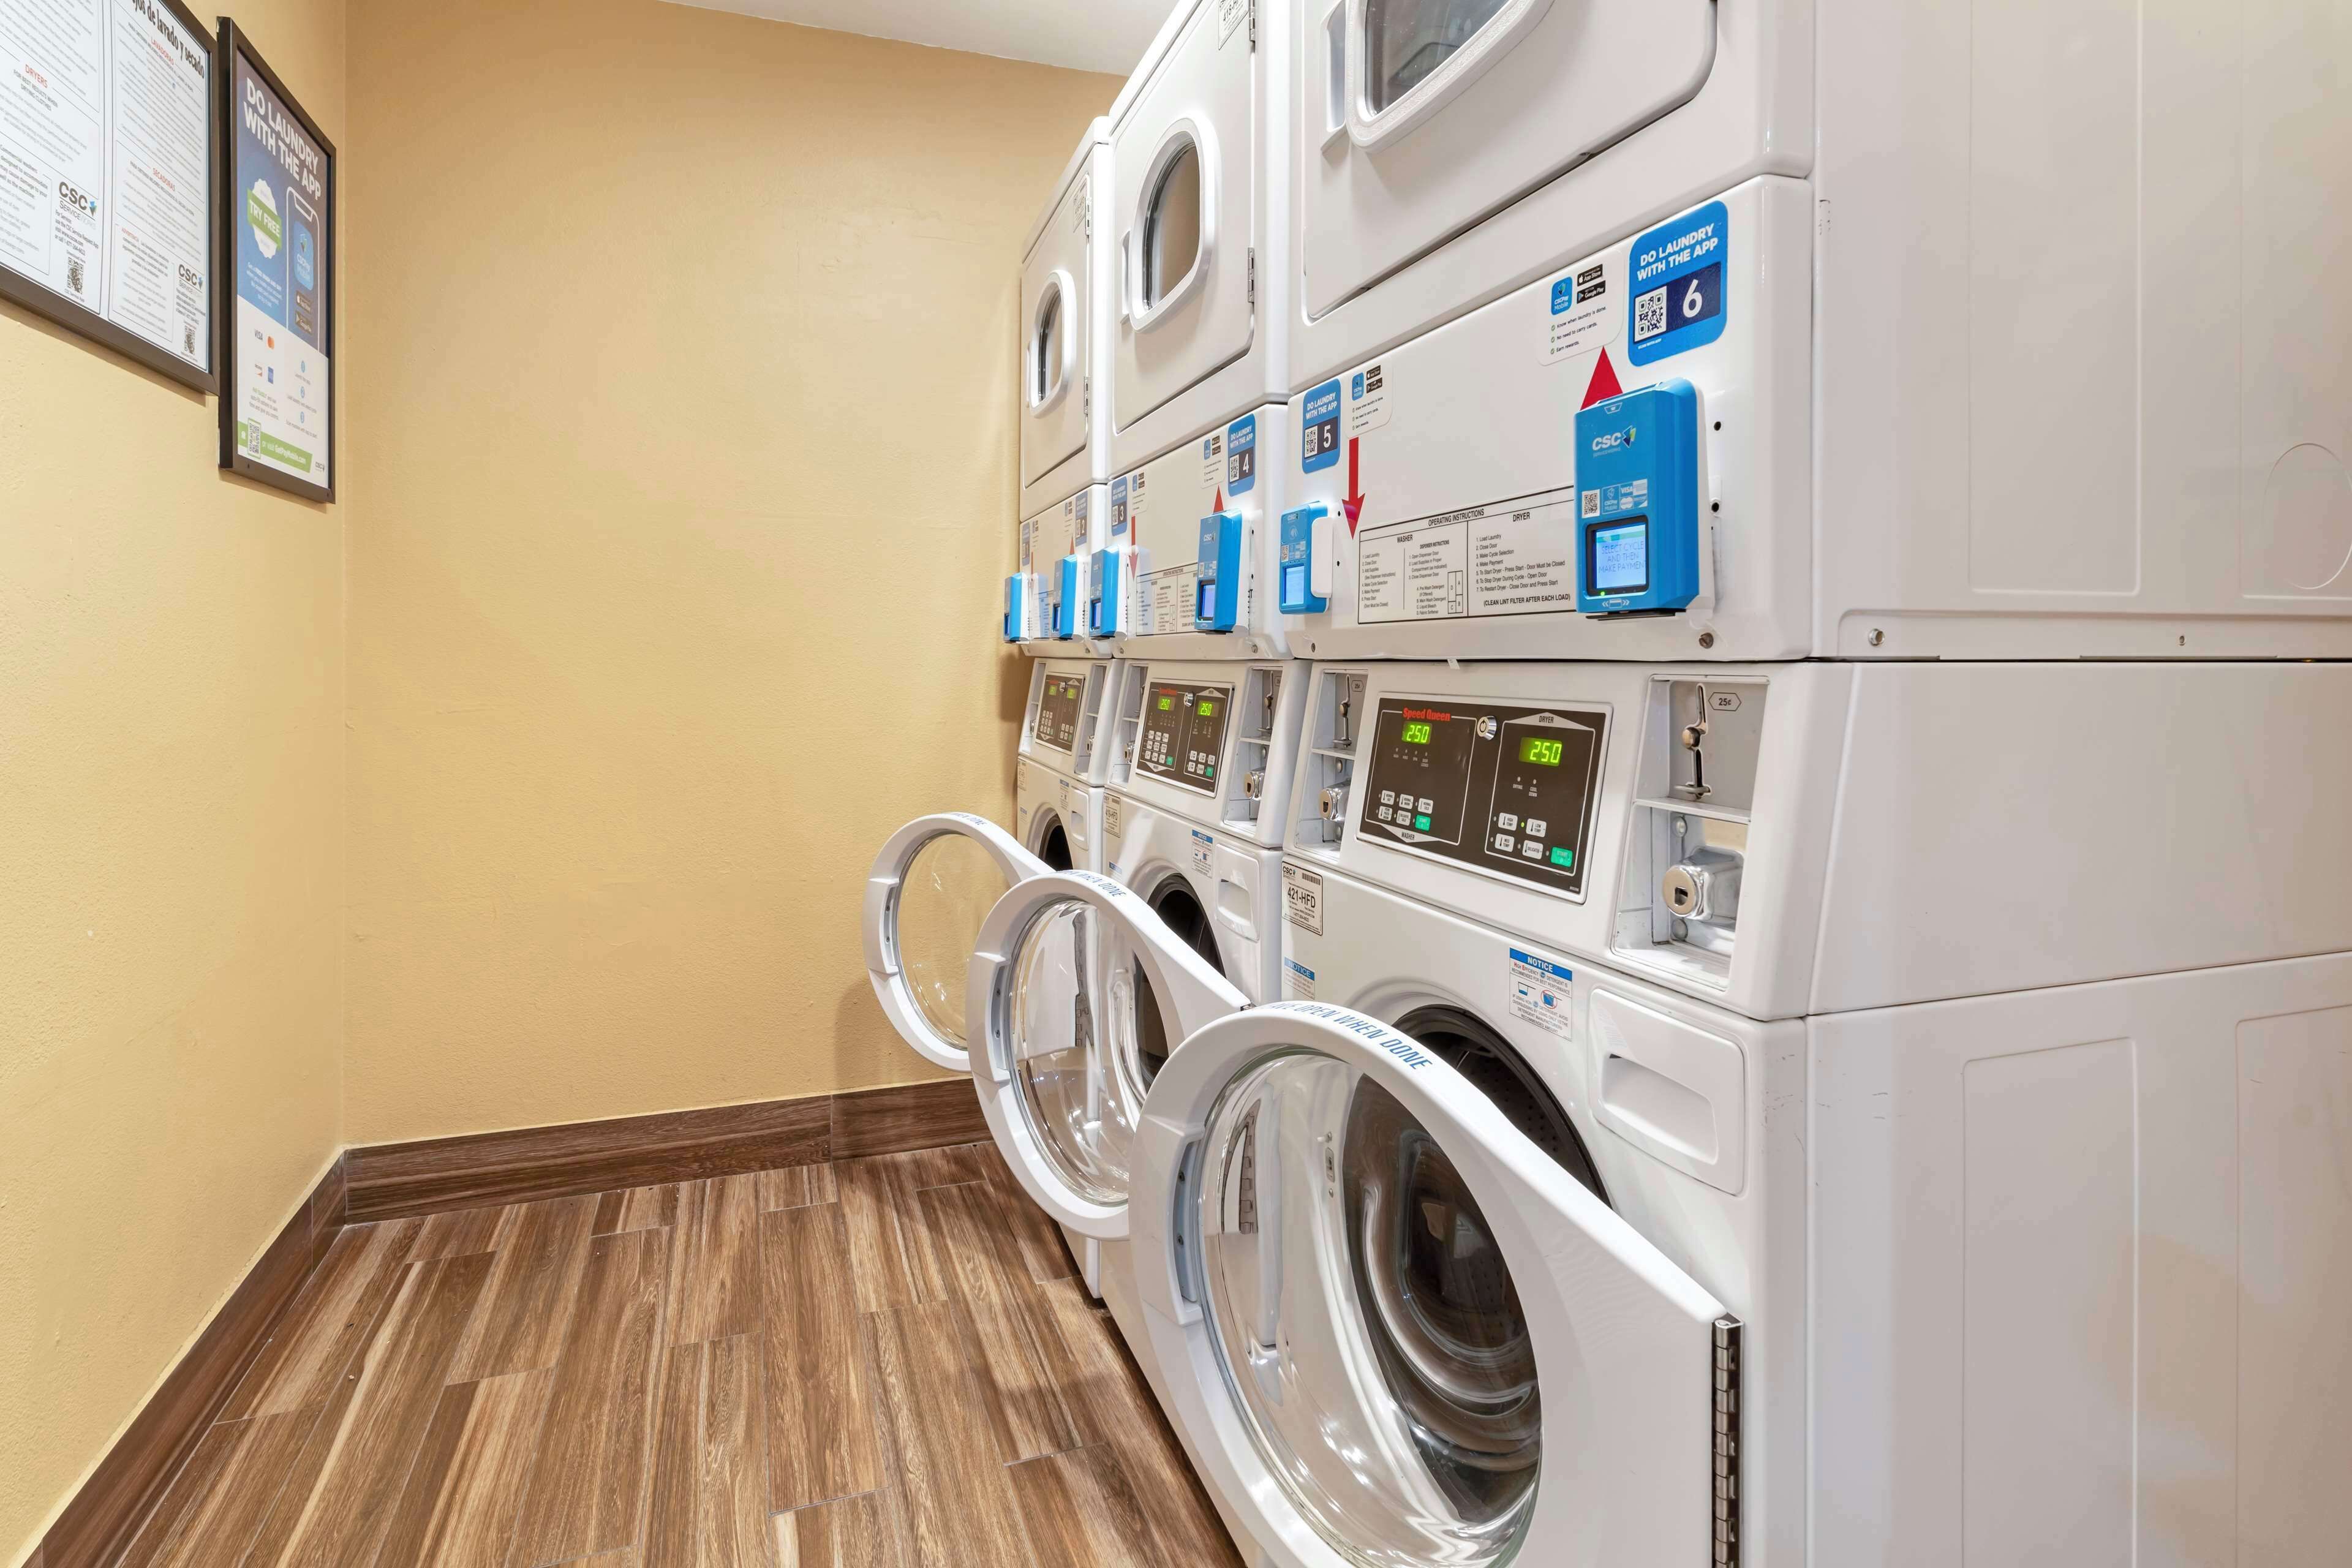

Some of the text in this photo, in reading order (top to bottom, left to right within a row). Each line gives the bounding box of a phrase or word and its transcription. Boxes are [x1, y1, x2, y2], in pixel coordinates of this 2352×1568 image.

[147, 0, 156, 26] de
[156, 9, 179, 51] lavado
[185, 47, 205, 79] secado
[25, 64, 48, 89] DRYERS
[247, 77, 318, 175] DO LAUNDRY
[244, 100, 322, 202] WITH THE APP
[59, 181, 88, 211] CSC
[249, 199, 281, 239] TRY FREE
[1640, 223, 1714, 266] DO LAUNDRY
[1637, 236, 1719, 281] WITH THE APP
[178, 263, 198, 286] CSC
[1591, 270, 1602, 279] Store
[1585, 290, 1597, 298] Google
[1683, 279, 1703, 318] 6
[1578, 312, 1591, 322] laundry
[254, 330, 263, 341] VISA
[1307, 391, 1336, 411] DO LAUNDRY
[1306, 401, 1338, 420] WITH THE APP
[1236, 425, 1252, 438] LAUNDRY
[1324, 424, 1331, 448] 5
[1230, 440, 1239, 448] WITH
[1592, 432, 1622, 451] CSC
[1243, 453, 1250, 473] 4
[1621, 486, 1634, 494] VISA
[1120, 505, 1124, 521] 3
[1428, 508, 1485, 527] OPERATING INSTRUCTIONS
[1513, 511, 1531, 522] DRYER
[1082, 519, 1085, 533] 2
[1204, 533, 1212, 542] CSC
[1397, 534, 1413, 543] WASHER
[1602, 540, 1645, 554] SELECT CYCLE
[1607, 551, 1640, 563] AND THEN
[1599, 565, 1616, 574] MAKE
[1483, 598, 1499, 607] (CLEAN
[1160, 699, 1170, 710] 250
[1200, 703, 1212, 715] 250
[1719, 697, 1732, 707] 25¢
[1403, 707, 1451, 722] Speed Queen
[1539, 715, 1555, 724] DRYER
[1406, 725, 1430, 744] 250
[1529, 741, 1562, 763] 250
[1401, 832, 1415, 840] WASHER
[1283, 865, 1293, 875] CSC
[1079, 872, 1102, 883] WHEN
[1098, 882, 1126, 897] DONE
[1287, 886, 1316, 908] 421-HFD
[1288, 960, 1311, 978] NOTICE
[1528, 956, 1553, 973] NOTICE
[1511, 967, 1533, 979] RECOMMENDED
[1521, 963, 1539, 976] EFFICIENCY
[1547, 975, 1564, 986] DETERGENT
[1517, 1006, 1536, 1019] DETERGENT
[1521, 1014, 1544, 1028] RECOMMENDED
[1294, 1005, 1433, 1070] OPEN WHEN DONE
